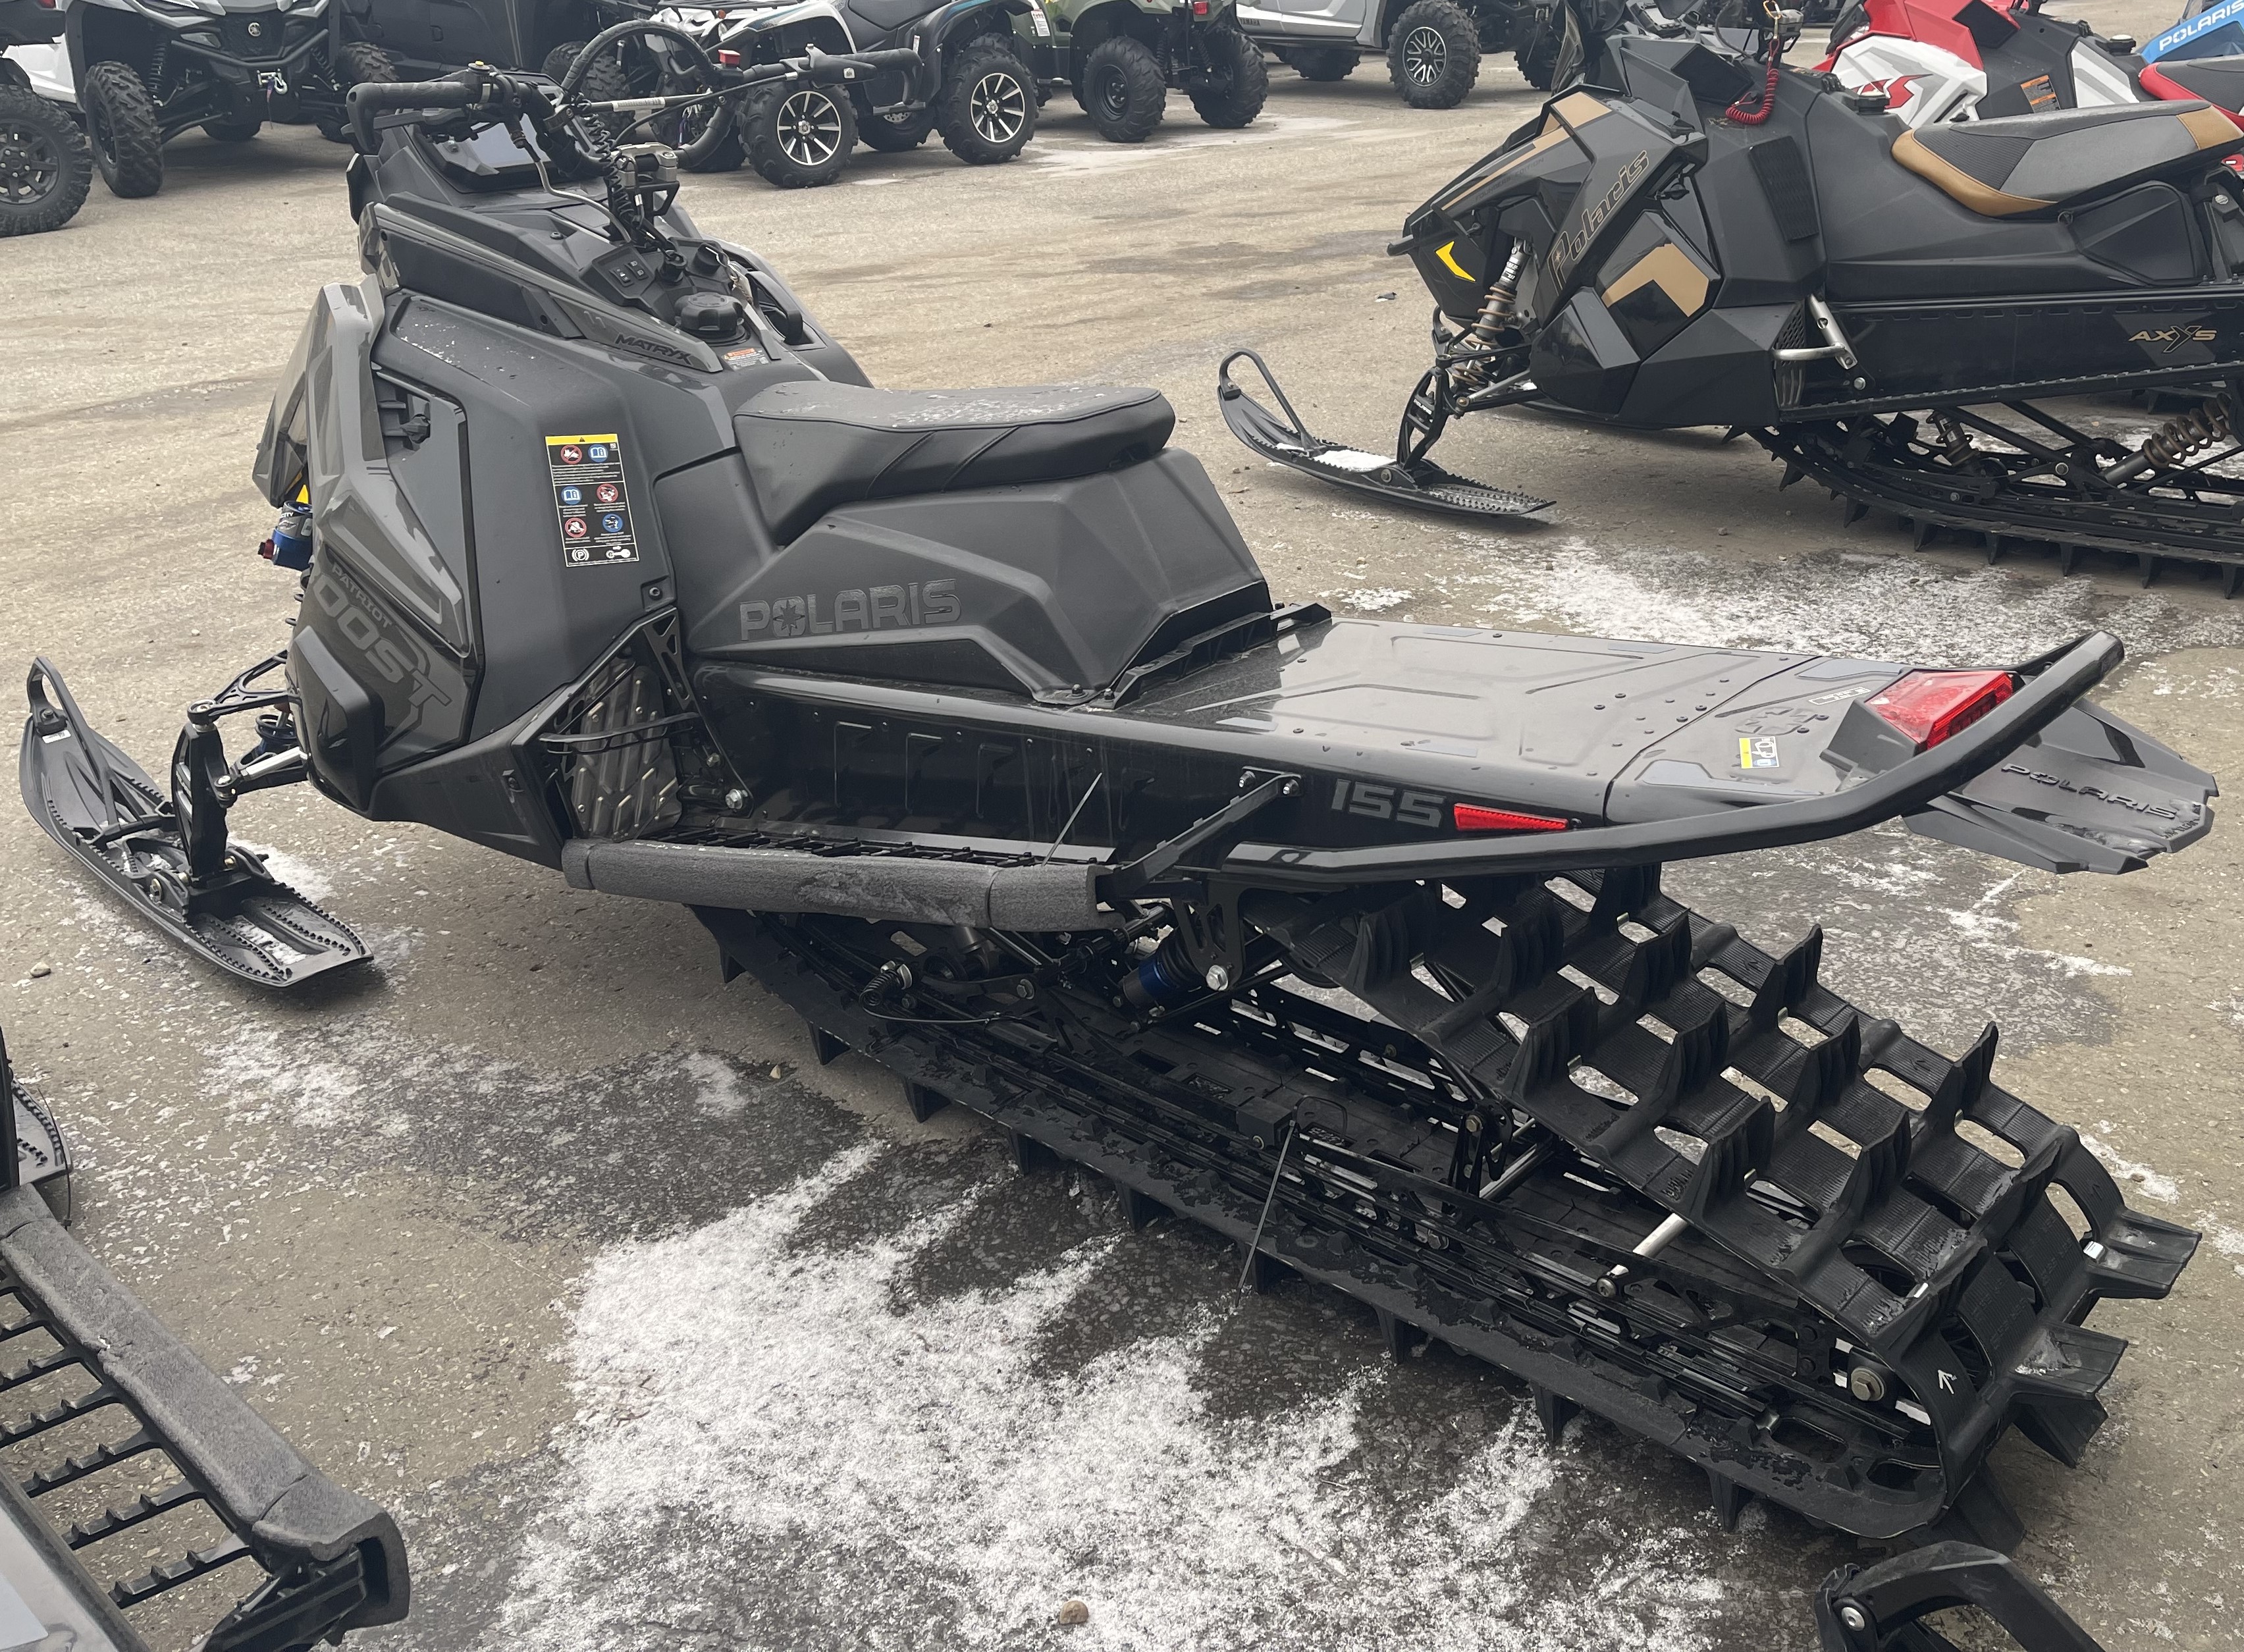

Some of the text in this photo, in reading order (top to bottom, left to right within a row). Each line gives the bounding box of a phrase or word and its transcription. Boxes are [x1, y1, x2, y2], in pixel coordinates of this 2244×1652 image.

[2159, 0, 2244, 51] POLARIS
[1547, 149, 1649, 296] Polaris
[614, 333, 694, 367] MATRYX
[2128, 325, 2218, 353] AXYS
[332, 562, 393, 629] PATRIOT
[739, 578, 962, 641] POLARIS
[311, 570, 453, 708] OOST
[1331, 778, 1447, 828] 155
[2000, 762, 2177, 820] POLARIS
